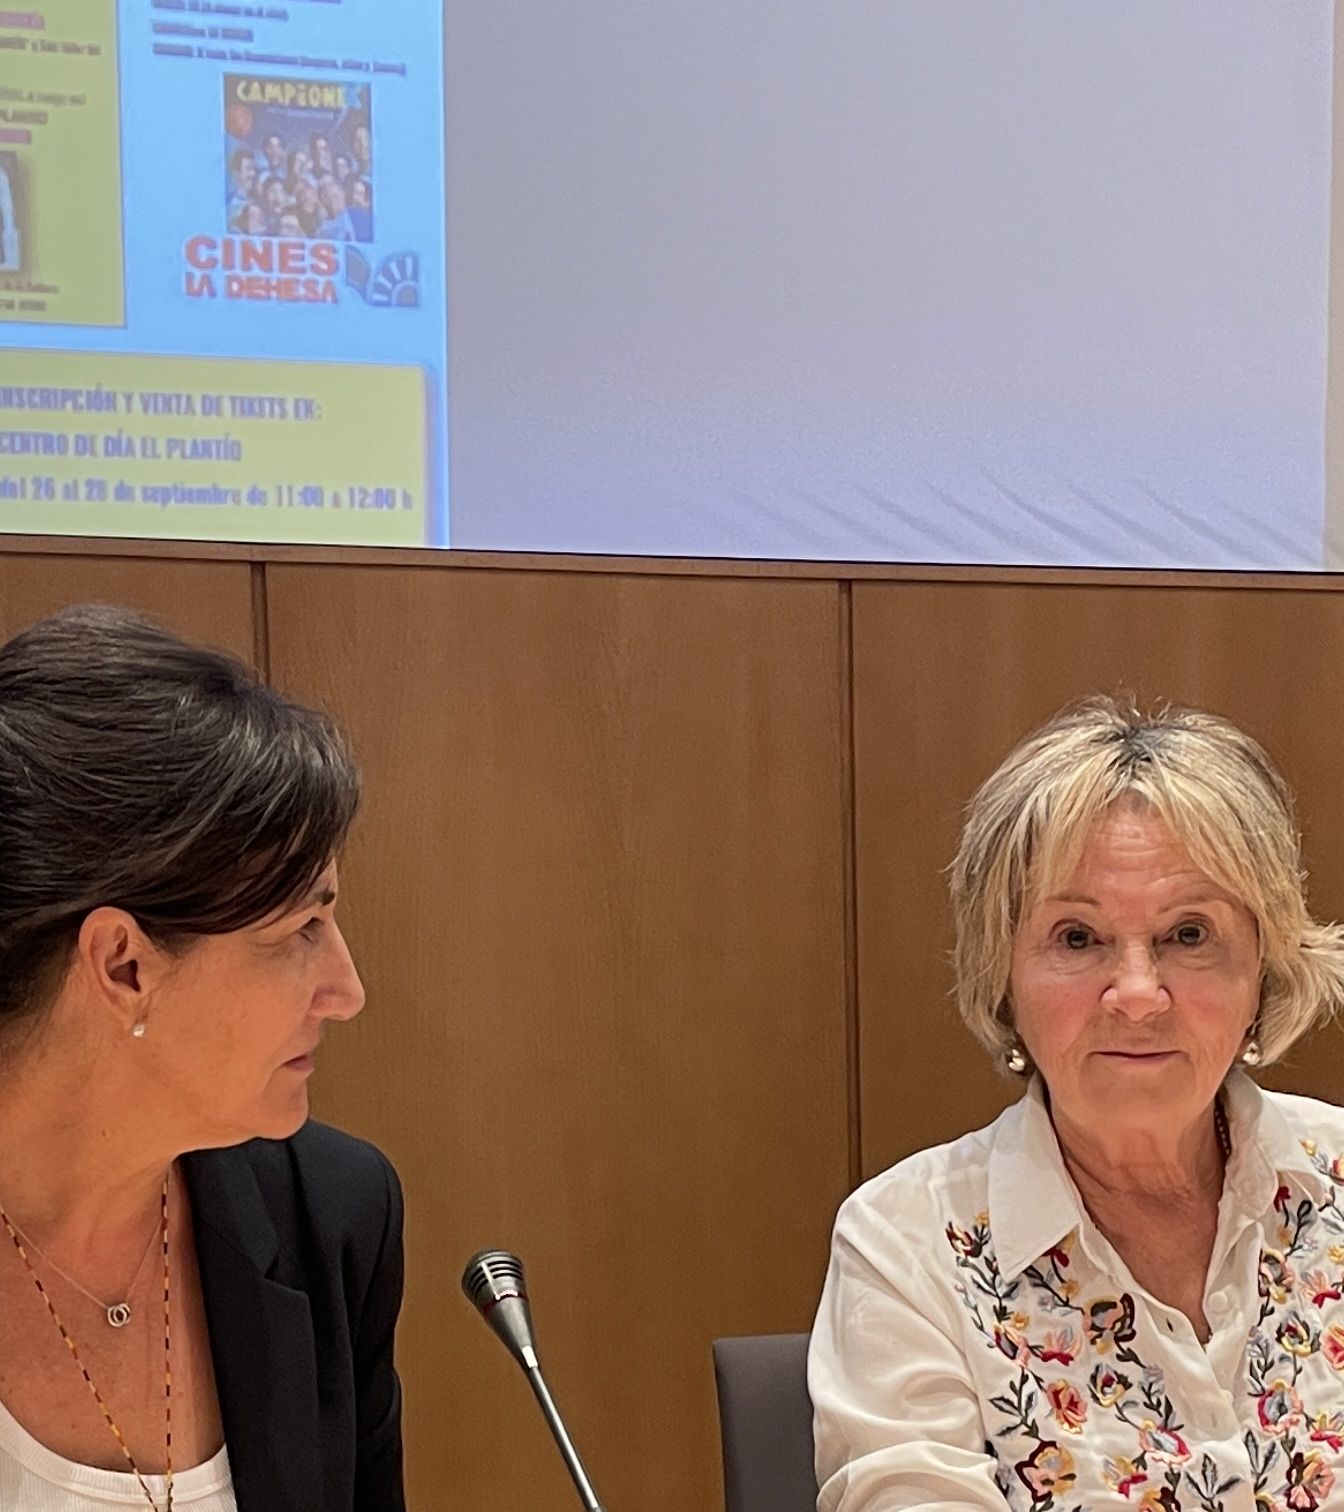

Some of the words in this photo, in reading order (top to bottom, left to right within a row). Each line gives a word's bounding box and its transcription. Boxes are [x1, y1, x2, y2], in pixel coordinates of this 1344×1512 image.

[185, 235, 340, 276] CINES
[186, 272, 216, 299] LA
[226, 274, 338, 303] DEHESA
